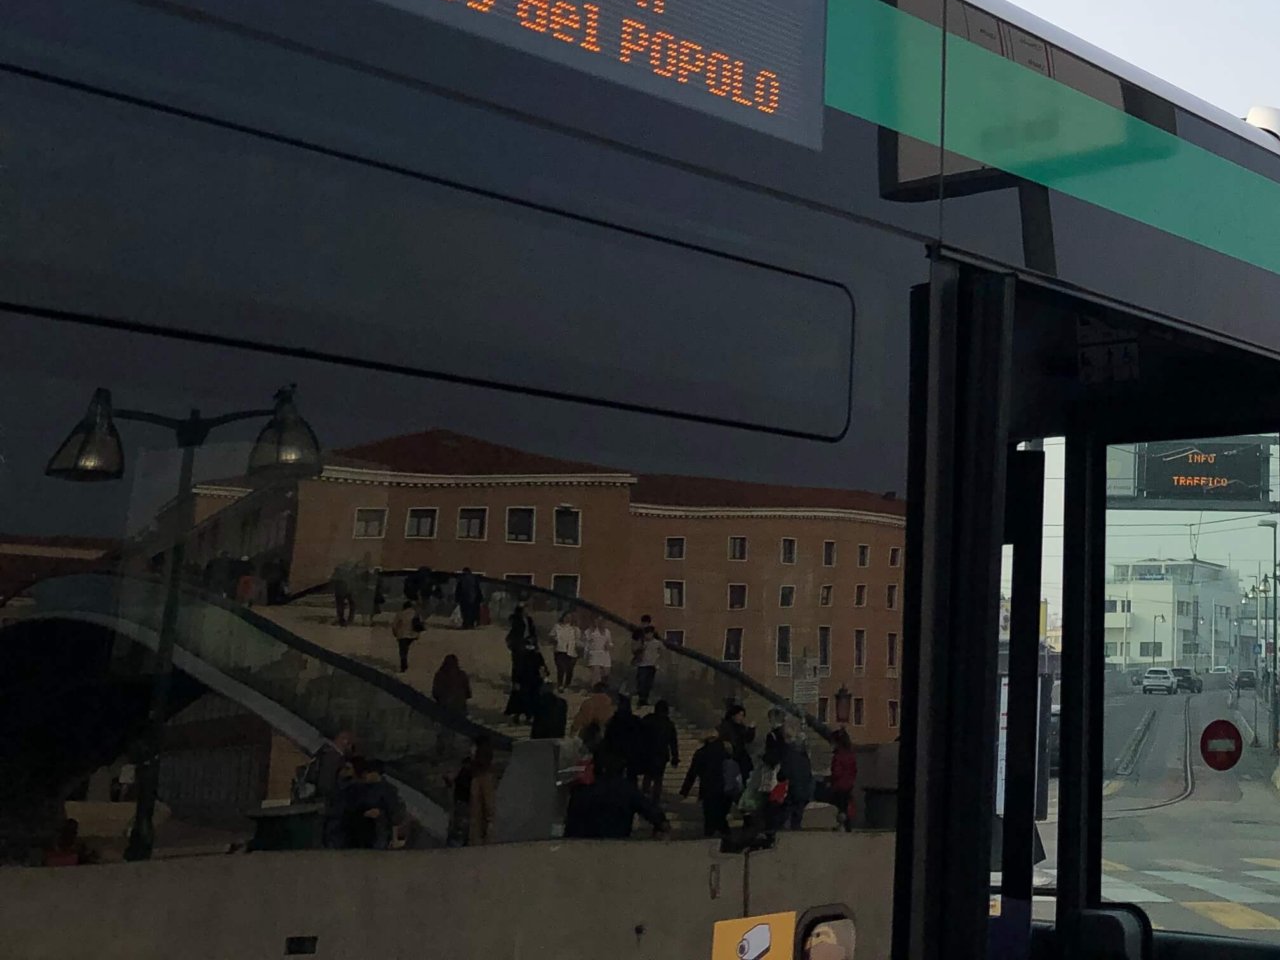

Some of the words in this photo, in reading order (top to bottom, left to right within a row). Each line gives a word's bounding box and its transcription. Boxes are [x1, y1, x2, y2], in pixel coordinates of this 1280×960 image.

[620, 18, 779, 113] POPOLO
[1188, 453, 1216, 464] INFO
[1172, 476, 1228, 488] TRAFFICO
